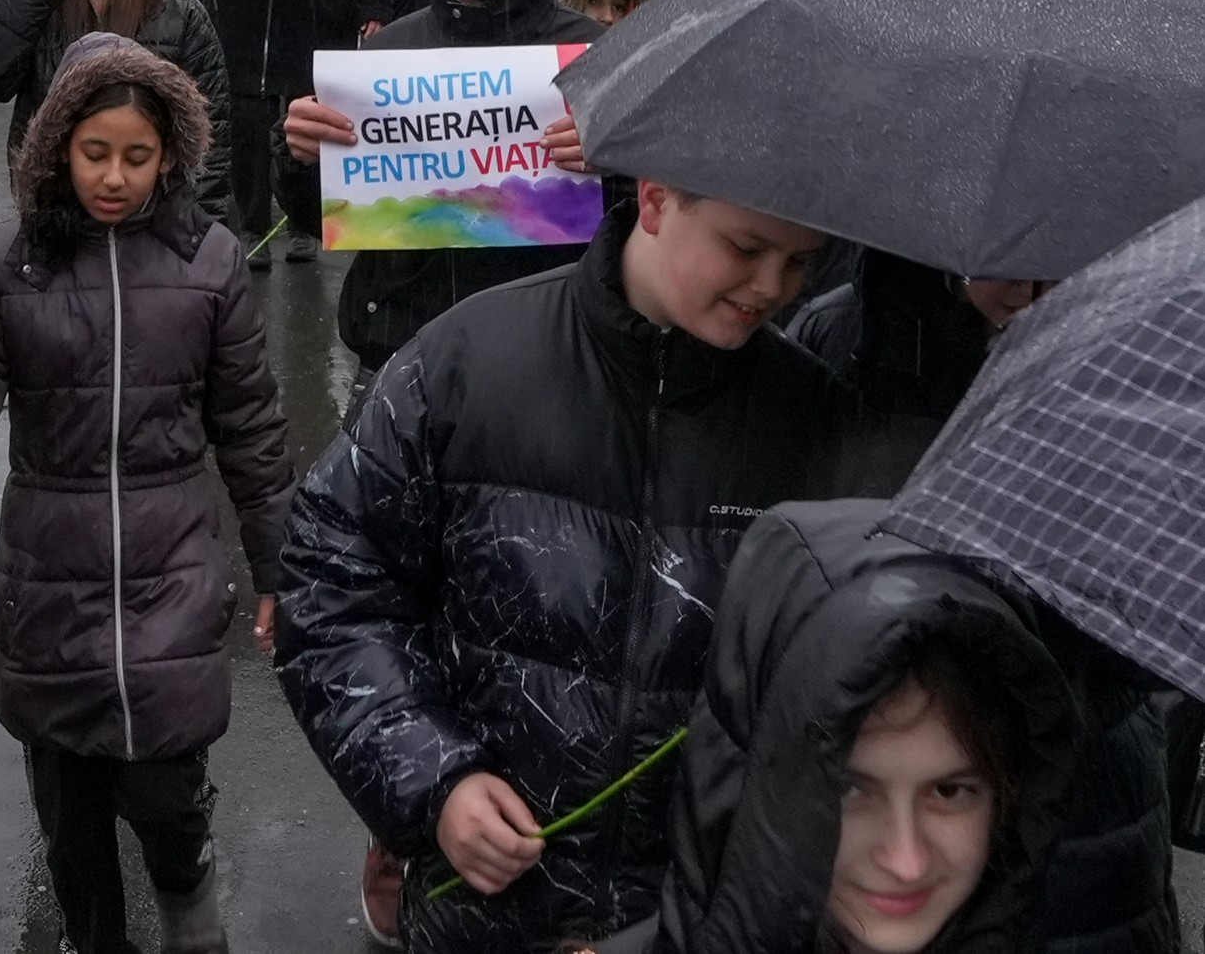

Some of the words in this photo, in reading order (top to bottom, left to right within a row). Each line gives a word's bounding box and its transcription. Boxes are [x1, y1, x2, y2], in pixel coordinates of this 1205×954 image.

[373, 68, 513, 108] SUNTEM
[361, 104, 539, 144] GENERAȚIA
[343, 150, 465, 185] PENTRU
